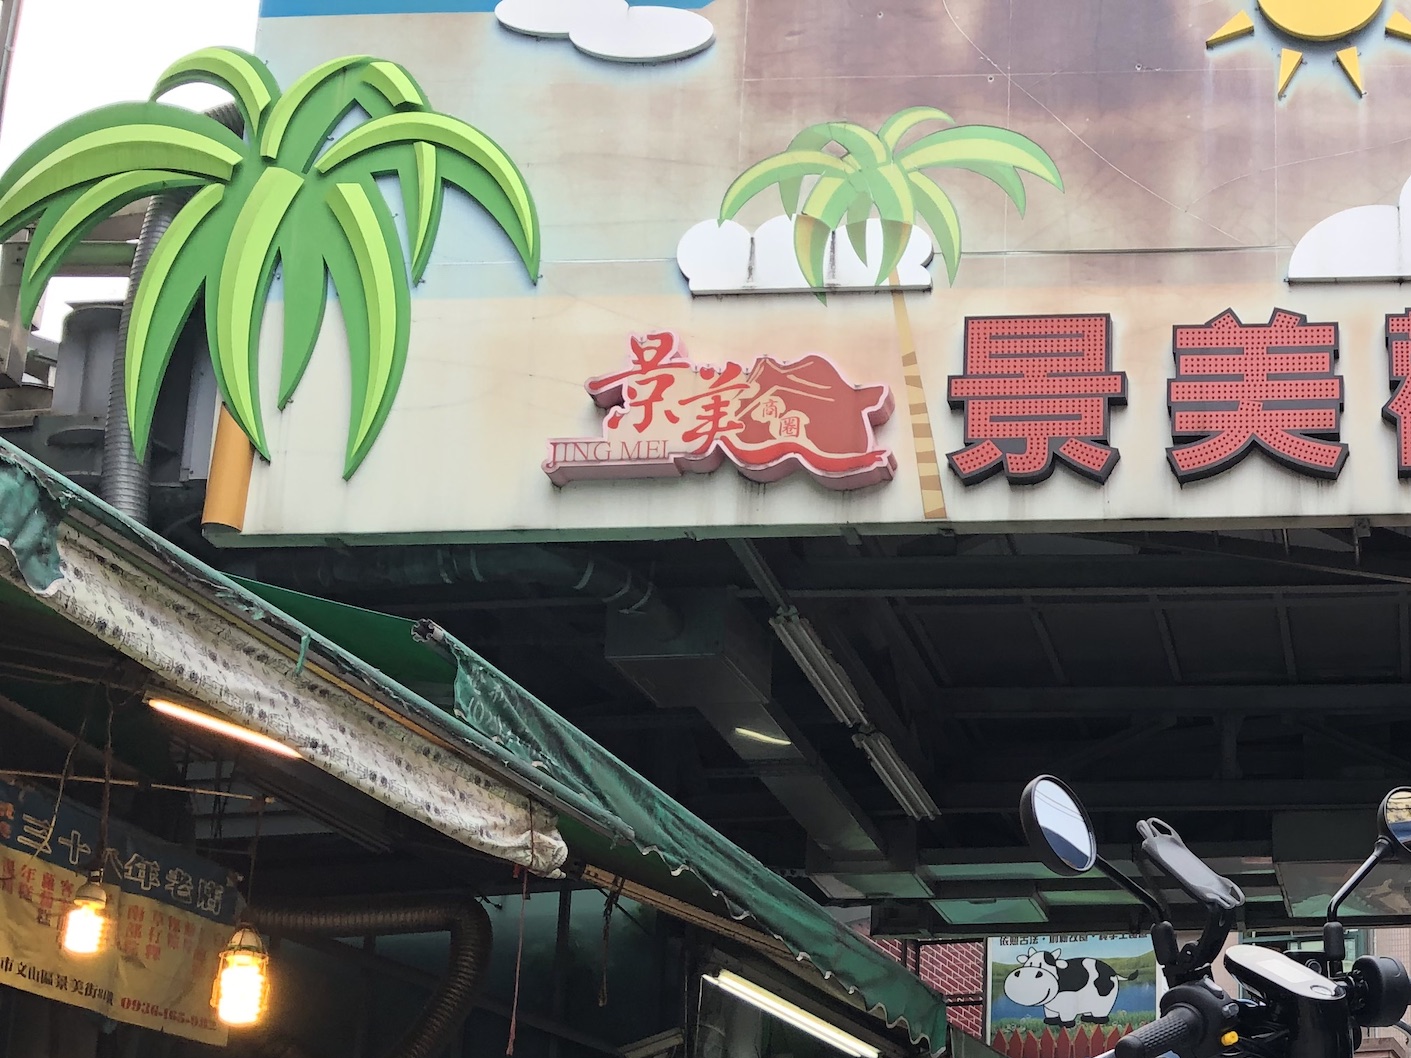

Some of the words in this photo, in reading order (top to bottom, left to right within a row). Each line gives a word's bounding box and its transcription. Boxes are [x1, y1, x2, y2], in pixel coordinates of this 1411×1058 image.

[762, 399, 800, 438] 商圈
[549, 440, 612, 467] JING
[620, 440, 669, 460] MEI
